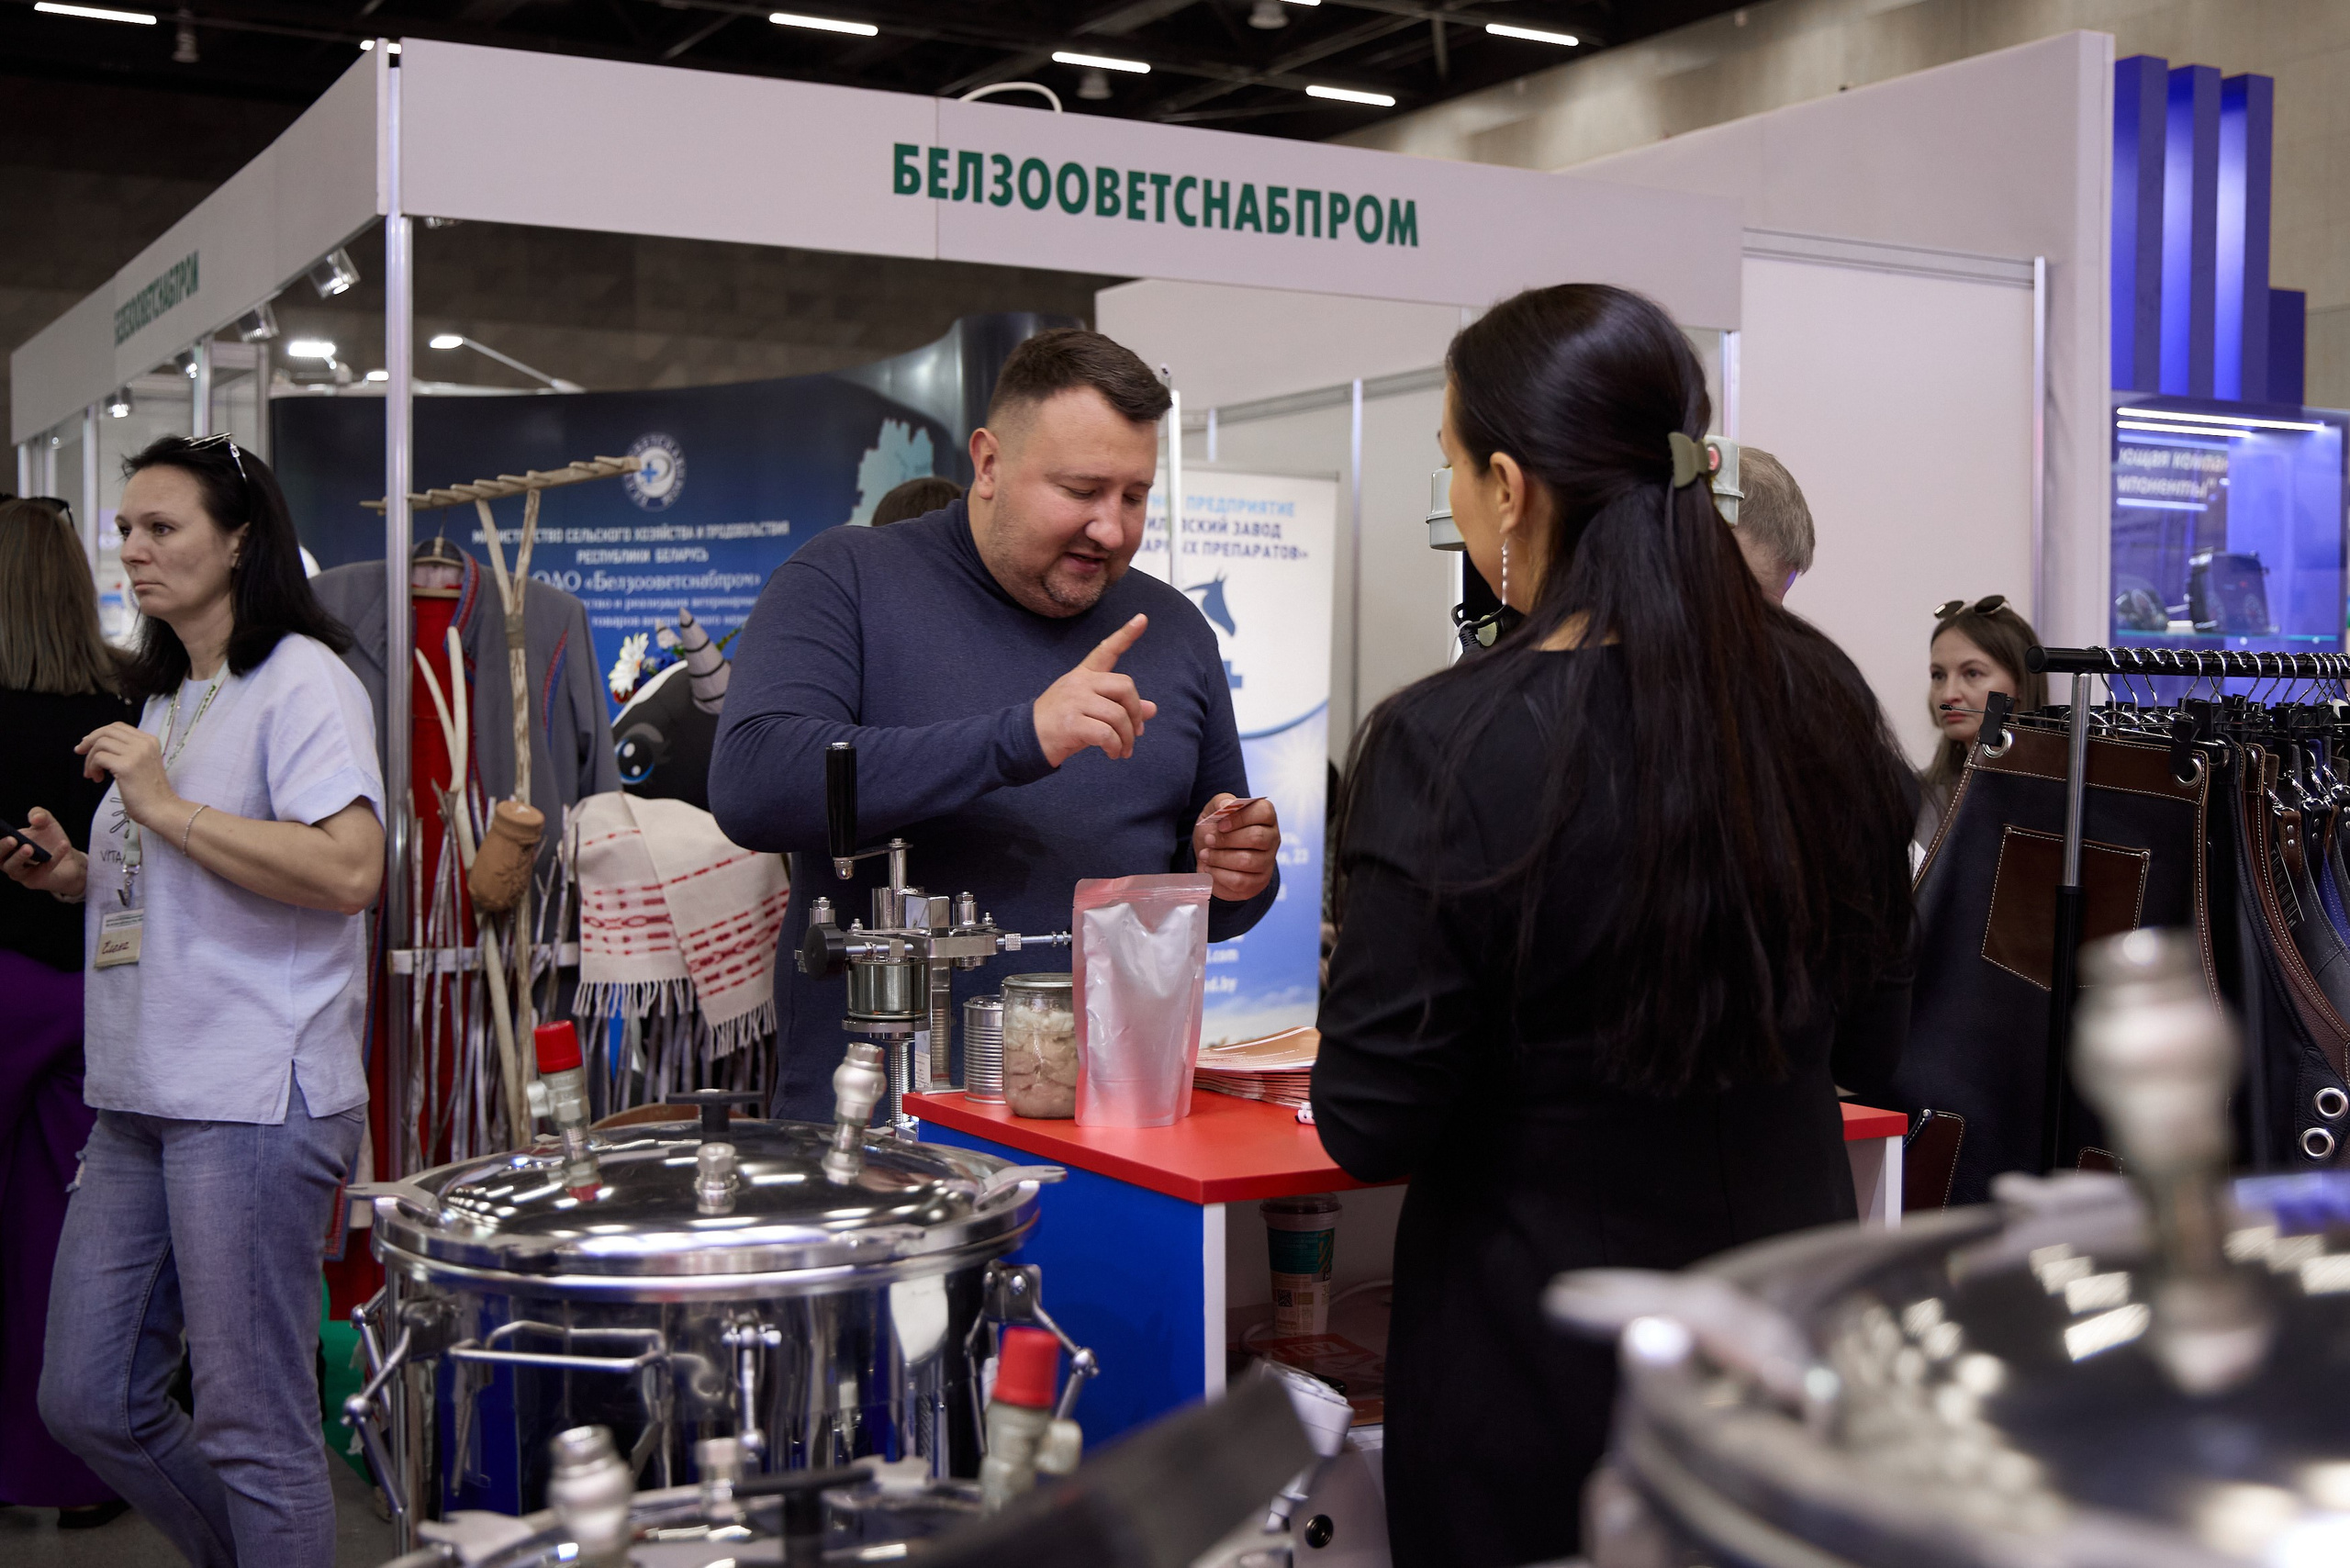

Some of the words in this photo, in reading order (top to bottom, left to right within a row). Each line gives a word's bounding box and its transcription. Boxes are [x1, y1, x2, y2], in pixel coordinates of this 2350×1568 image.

[892, 142, 1419, 248] БЕЛЗООВЕТСНАБПРОМ
[1187, 495, 1295, 517] ПРЕДПРИЯТИЕ
[1234, 521, 1281, 539] ЗАВОД
